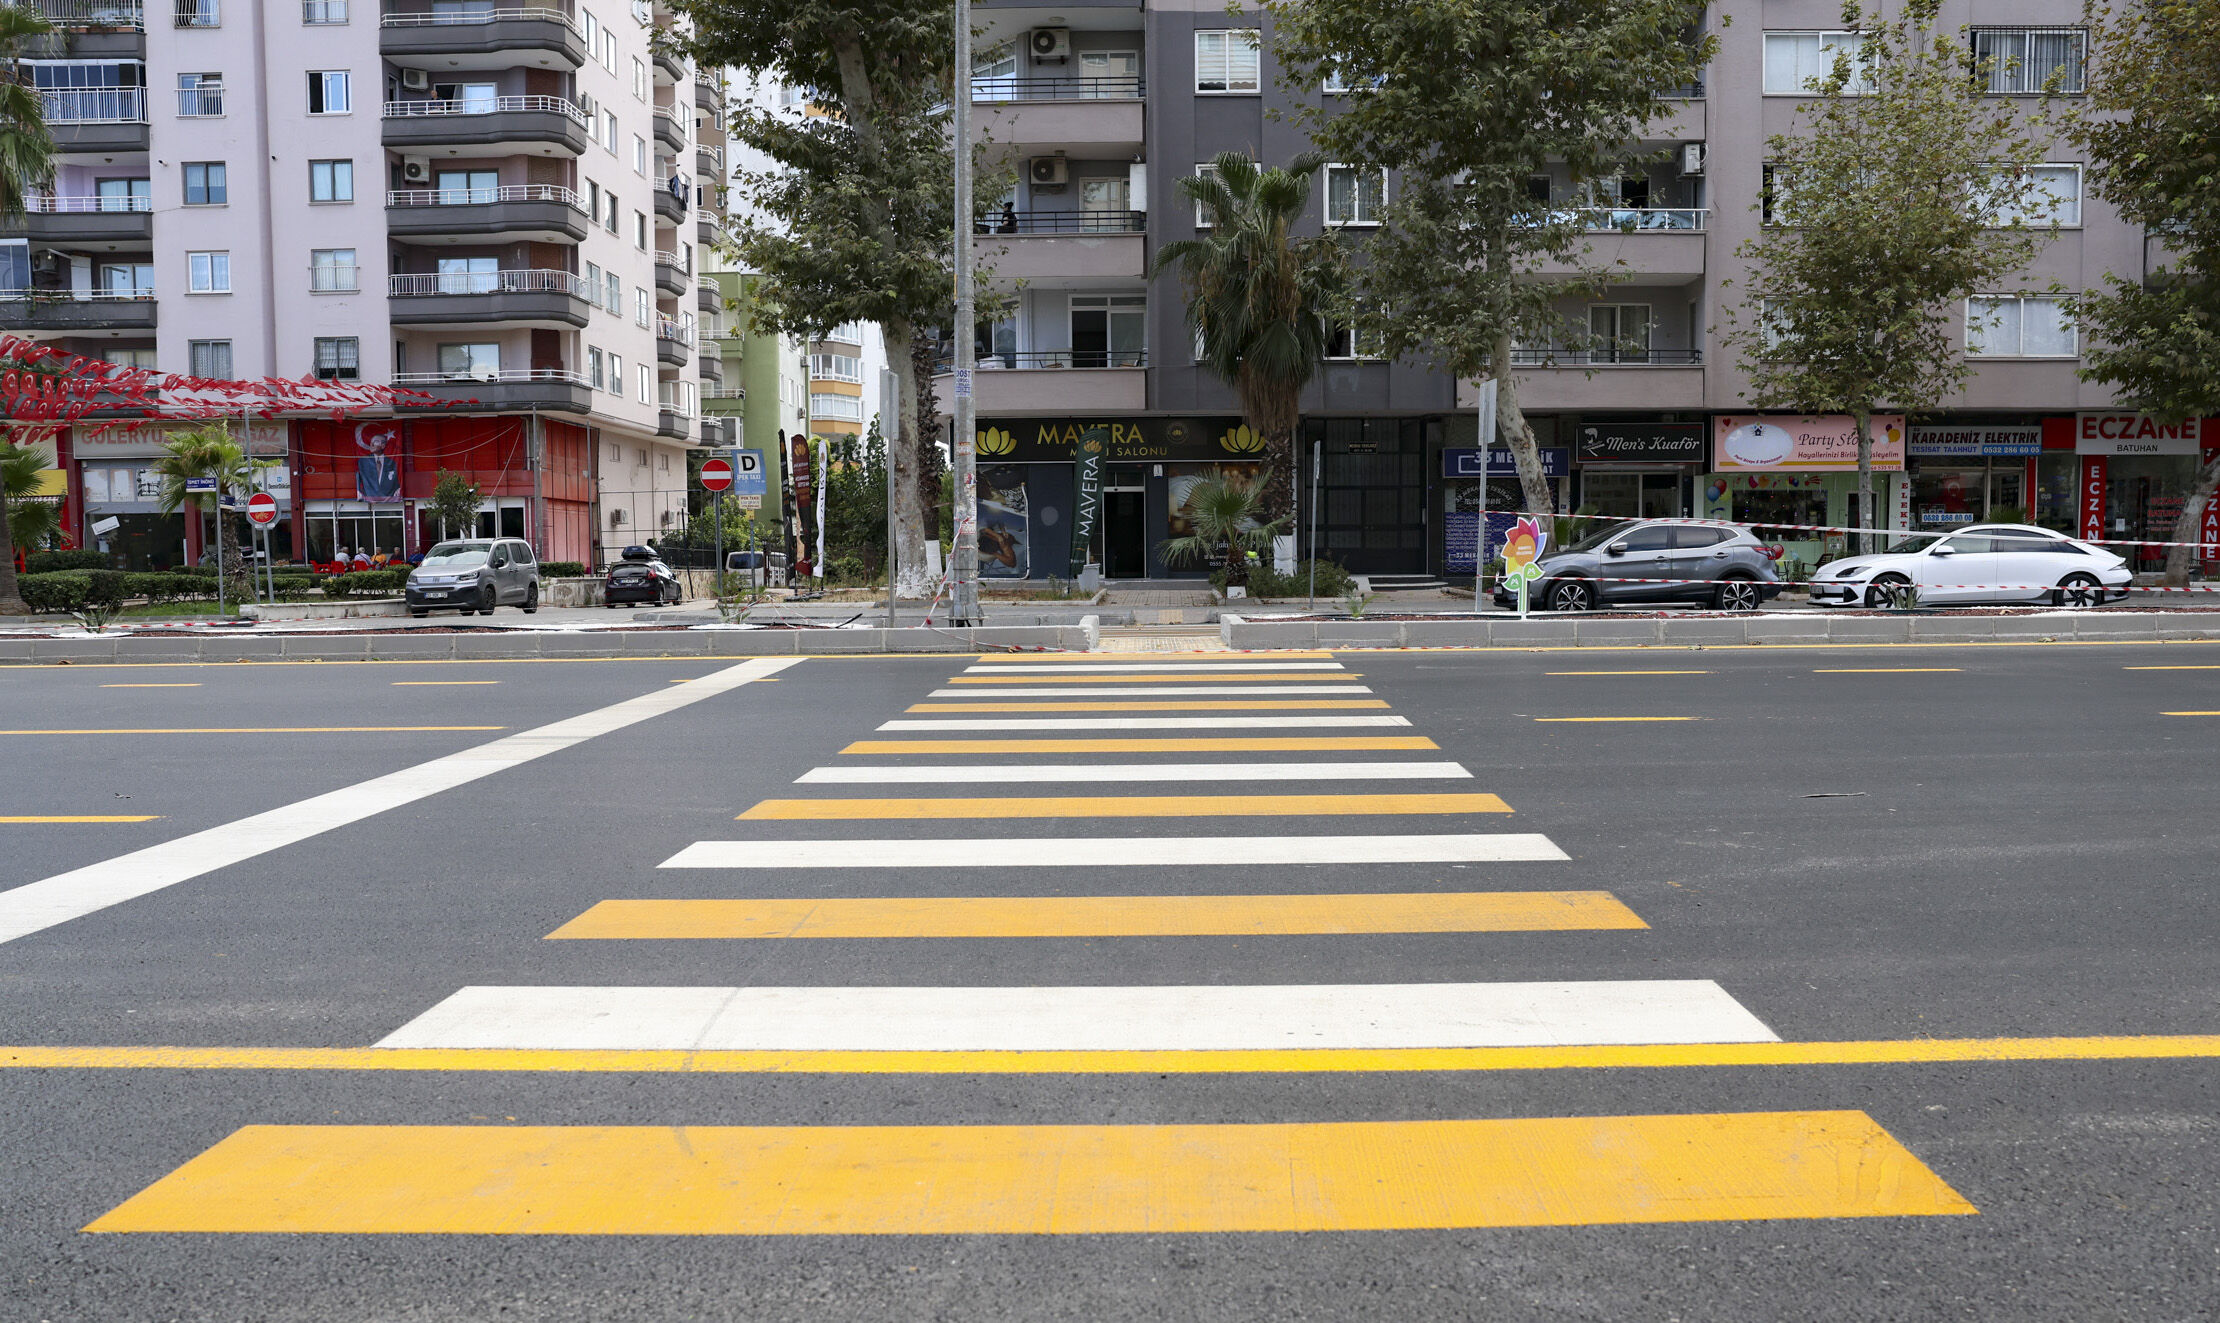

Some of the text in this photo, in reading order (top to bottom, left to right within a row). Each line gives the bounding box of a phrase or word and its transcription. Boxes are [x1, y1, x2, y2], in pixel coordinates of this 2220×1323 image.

[2082, 416, 2196, 440] ECZANE
[1606, 436, 1700, 451] Men's Kuaför
[1798, 432, 1858, 450] Party Sto
[1911, 429, 2039, 444] KARADENİZ ELEKTRİK
[1117, 447, 1167, 456] SALONU
[1840, 451, 1858, 459] Birlik
[2117, 444, 2158, 452] BATUHAN
[741, 455, 755, 471] D
[1496, 451, 1553, 463] MEİK
[1079, 456, 1099, 536] MAVERA
[2087, 466, 2100, 540] ECZAN
